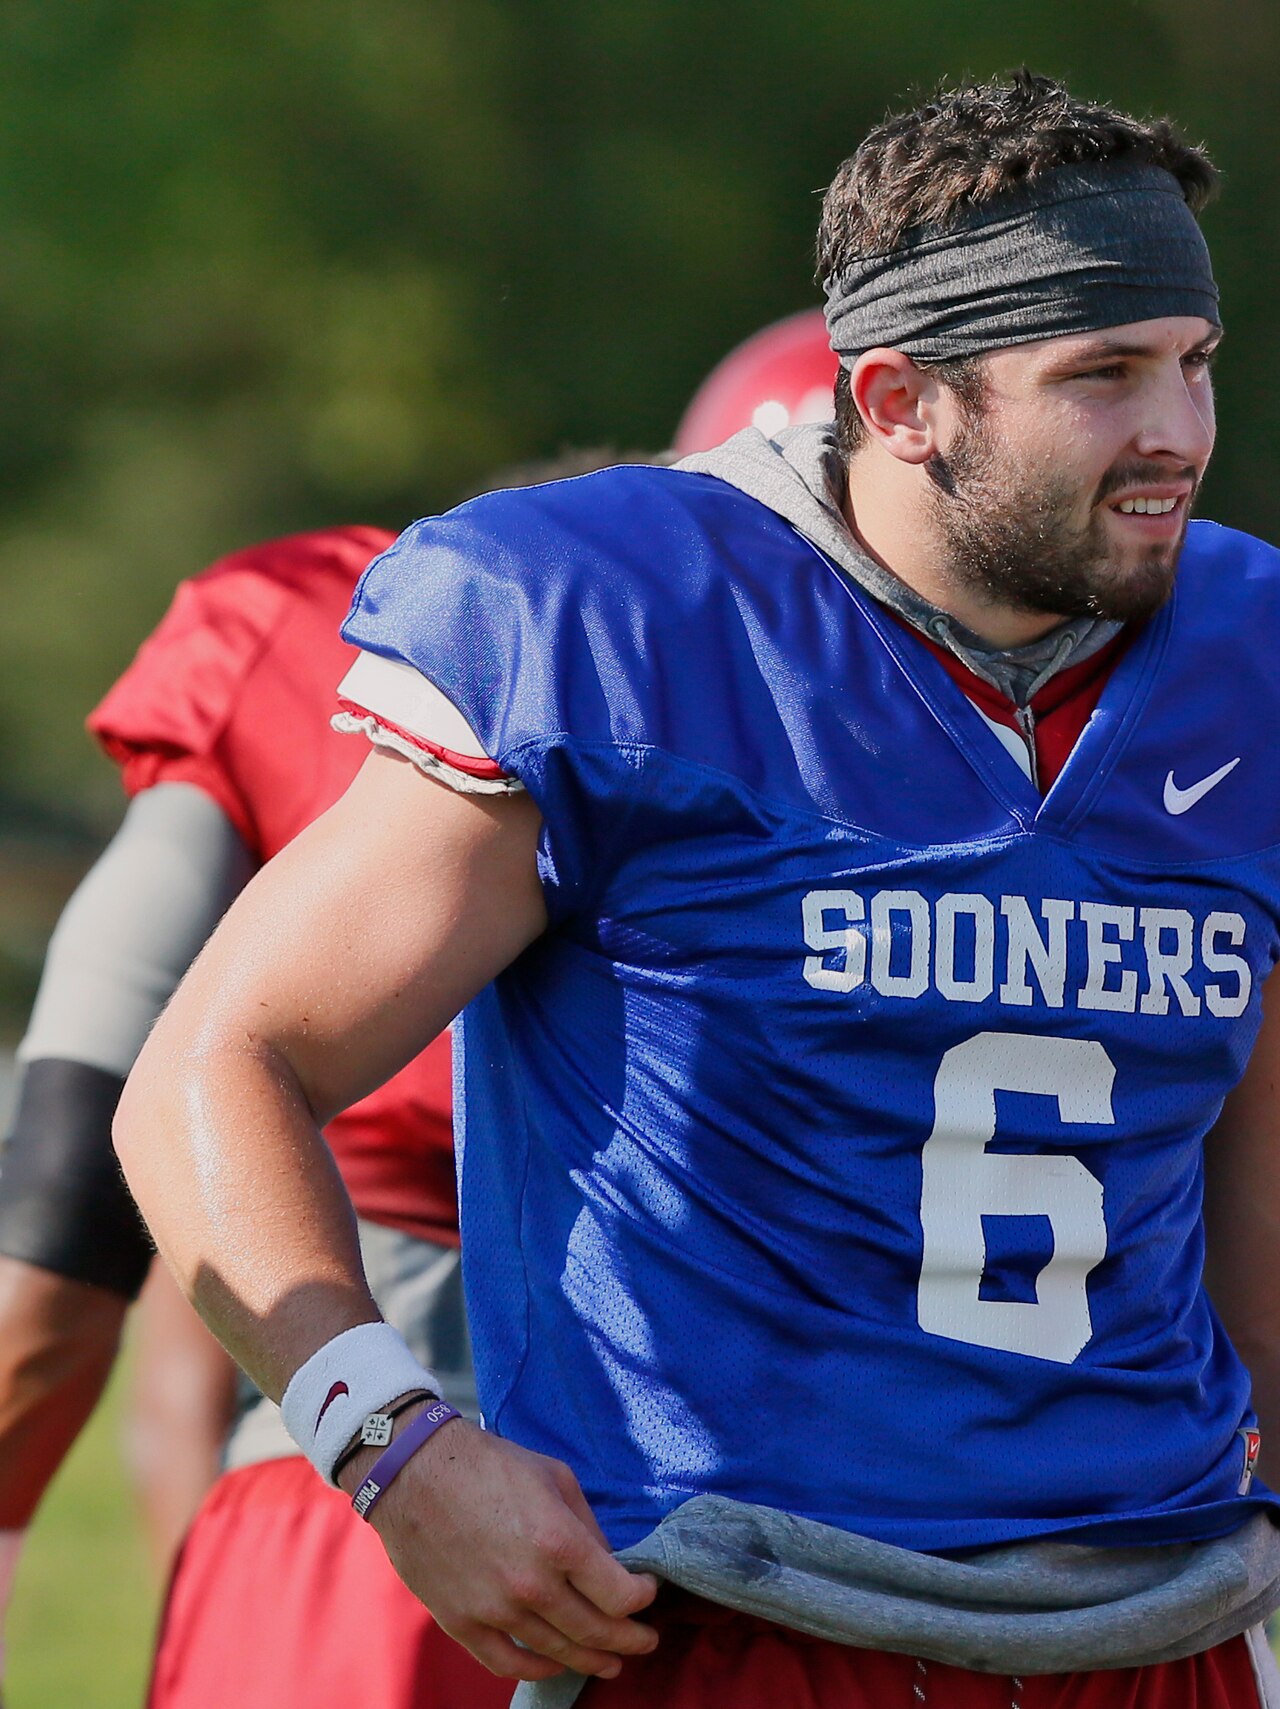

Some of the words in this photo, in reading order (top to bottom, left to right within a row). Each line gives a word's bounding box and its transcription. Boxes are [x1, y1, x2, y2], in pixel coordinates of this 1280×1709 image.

[801, 889, 1252, 1018] SOONERS
[917, 1031, 1117, 1365] 6
[426, 1403, 451, 1423] 8:50
